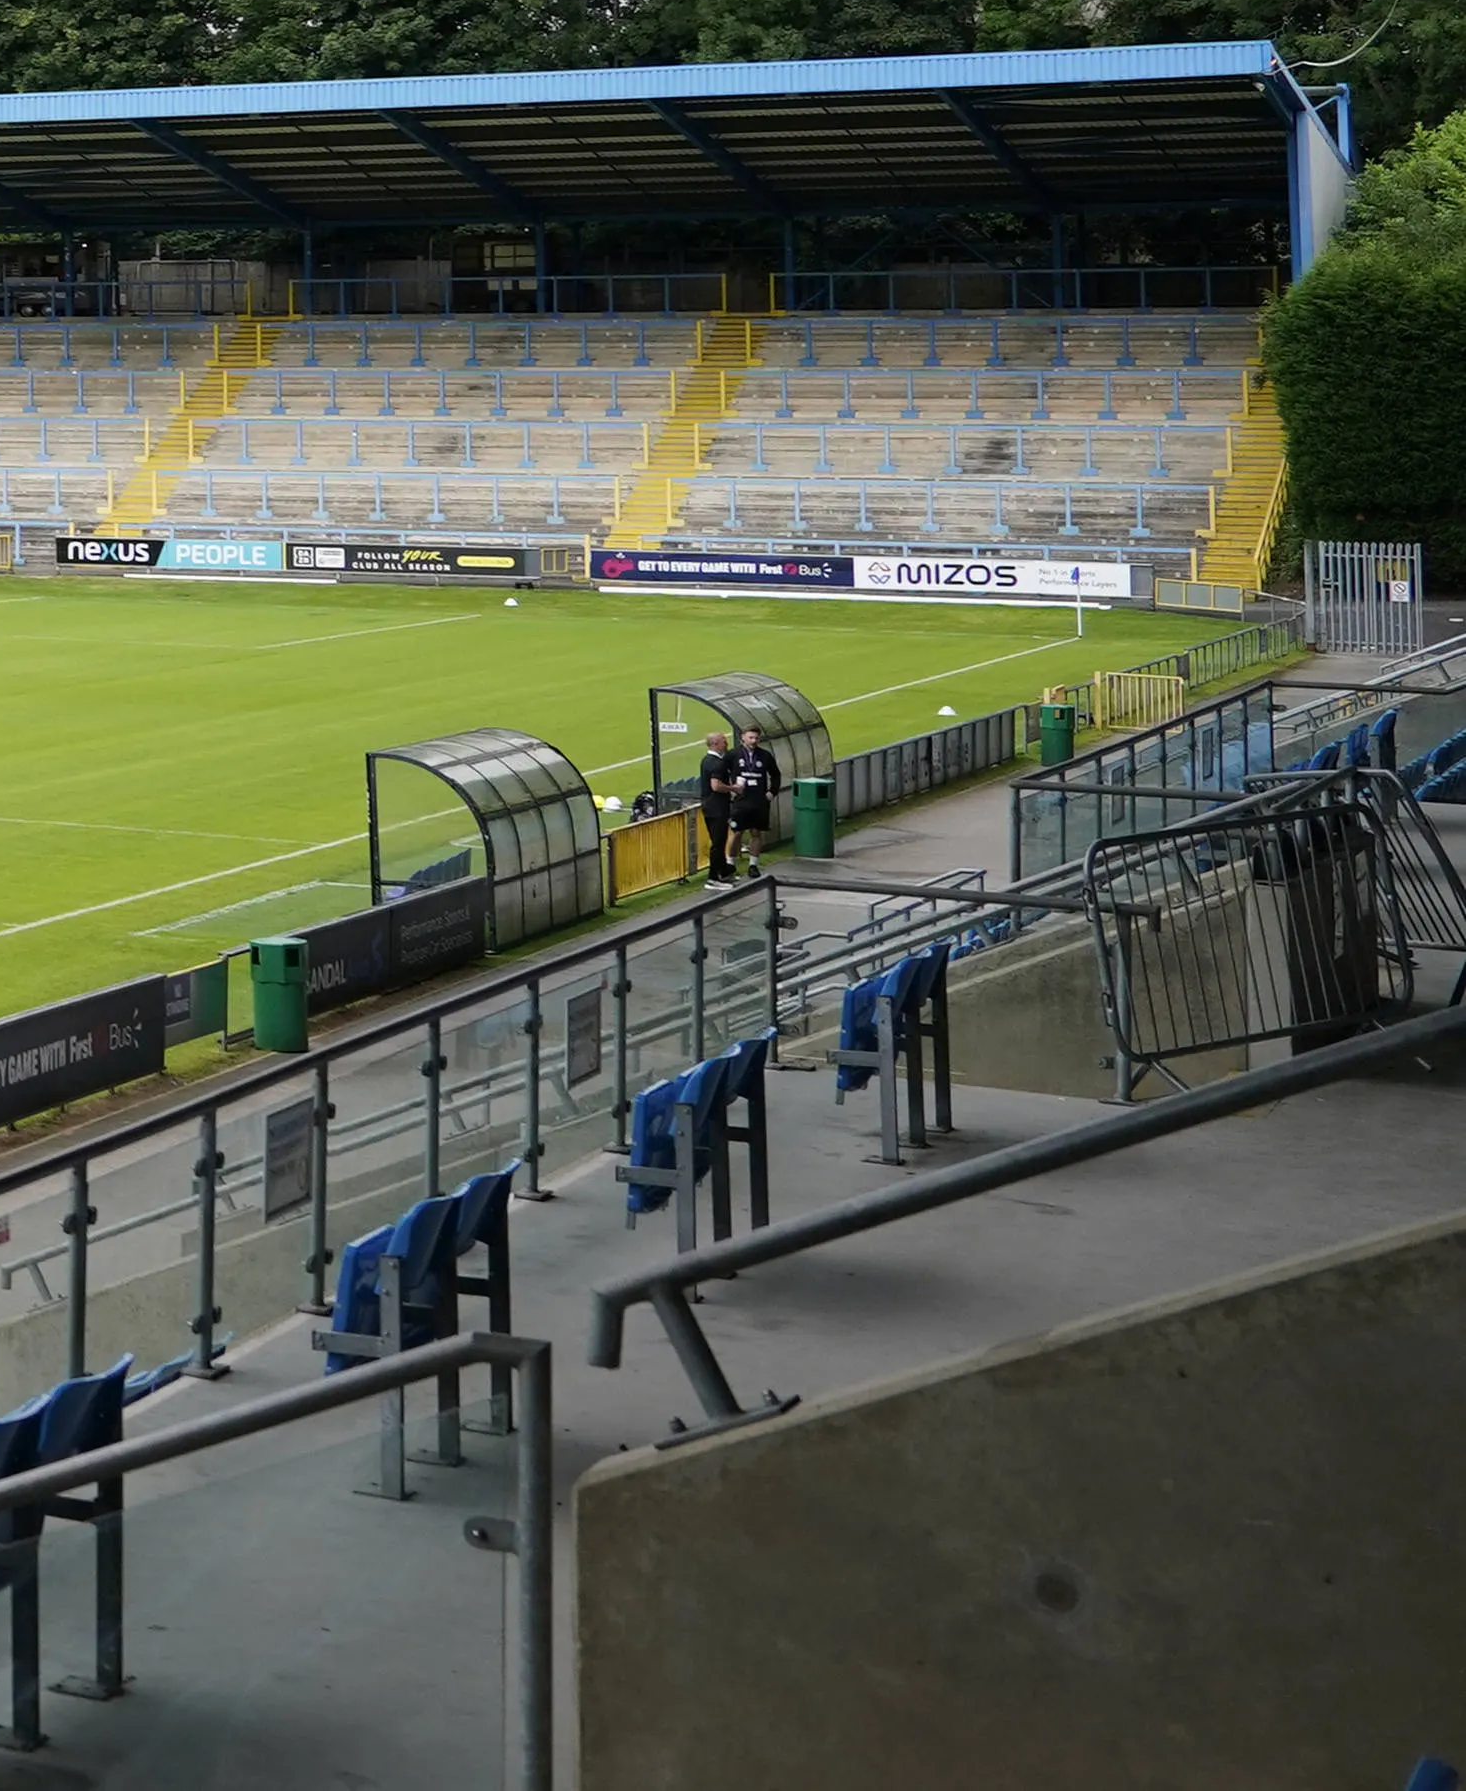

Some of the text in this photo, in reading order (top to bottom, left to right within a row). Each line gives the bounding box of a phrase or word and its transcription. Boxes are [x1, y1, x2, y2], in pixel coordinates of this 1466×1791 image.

[67, 541, 150, 562] nexus
[176, 544, 267, 566] PEOPLE
[357, 551, 400, 560] FOLLOW
[402, 550, 444, 563] YOUR
[383, 562, 403, 570] ALL
[408, 563, 451, 571] SEASON
[638, 560, 822, 576] GET TO EVERY GAME WITH First Bus
[897, 564, 1017, 586] MIZOS
[8, 1048, 38, 1085] GAME
[39, 1039, 67, 1073] WITH
[69, 1032, 94, 1063] First
[109, 1022, 133, 1051] Bus
